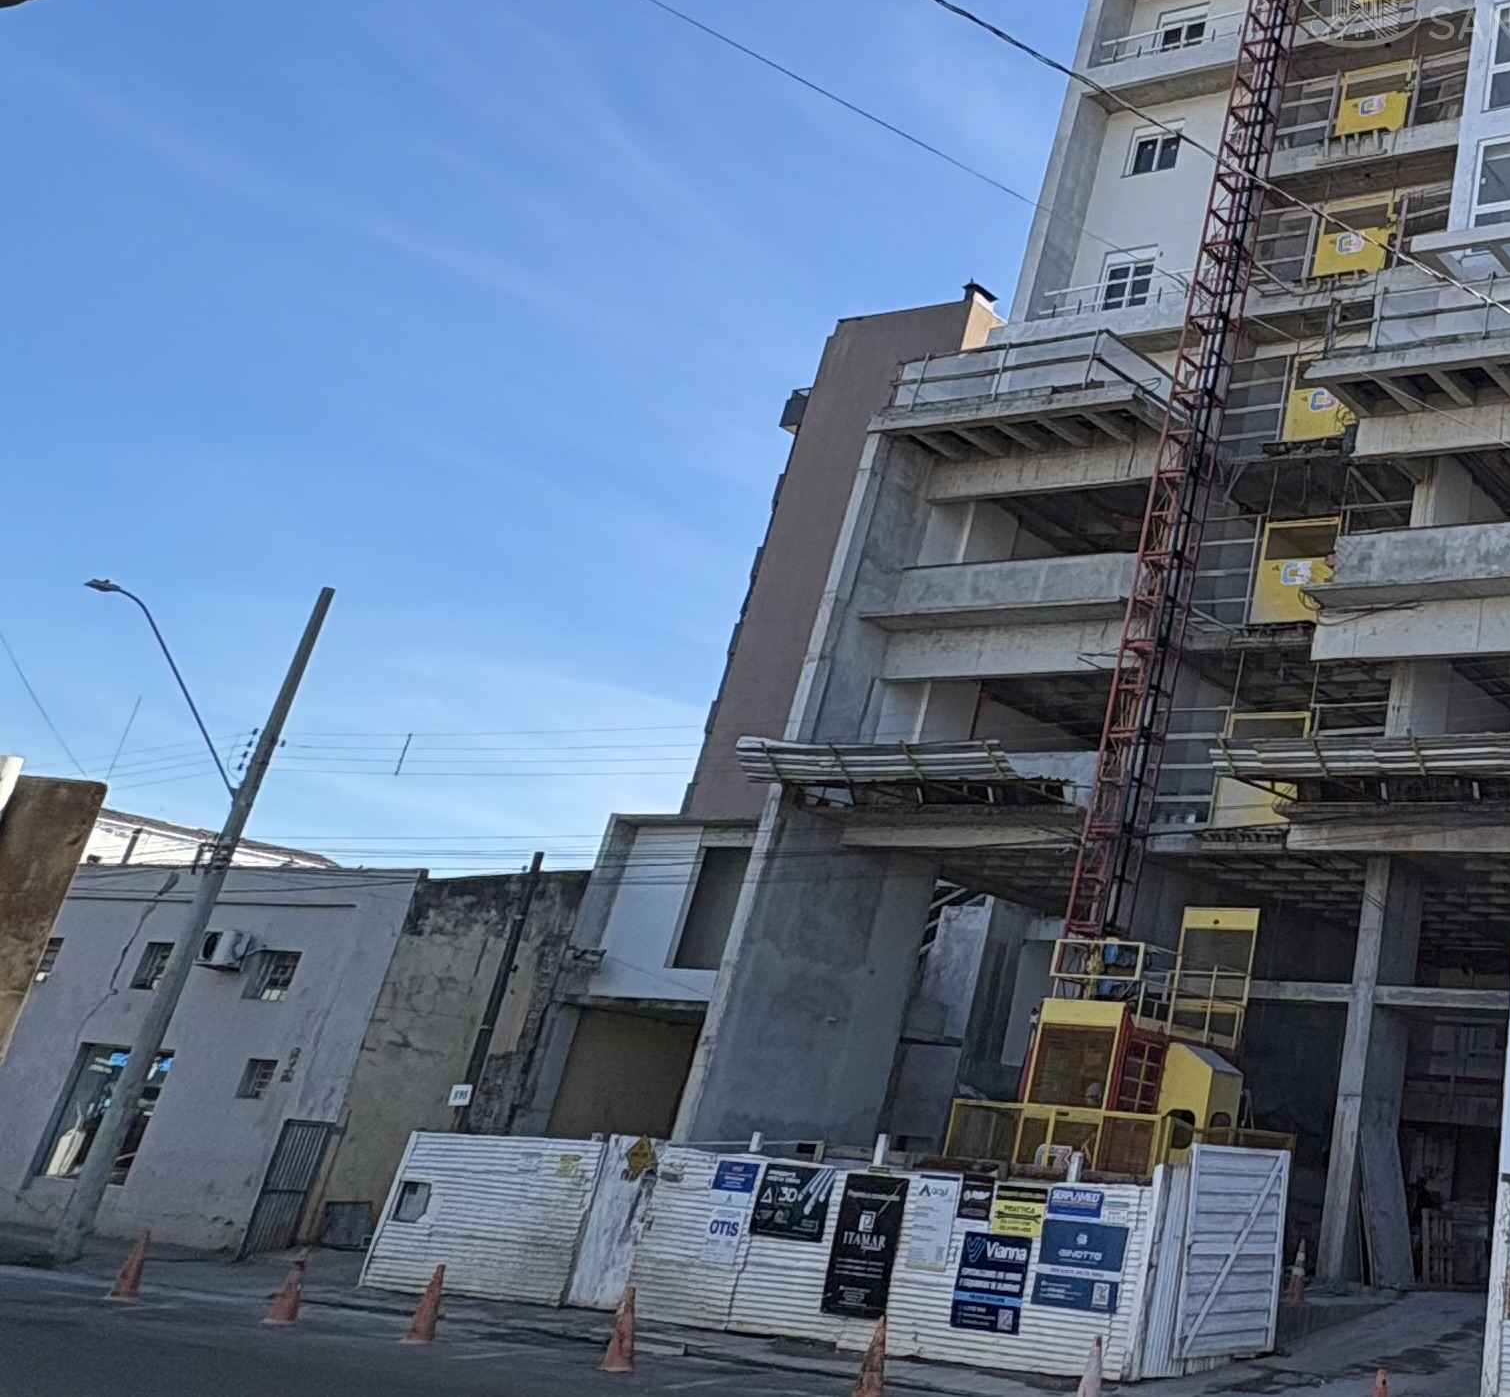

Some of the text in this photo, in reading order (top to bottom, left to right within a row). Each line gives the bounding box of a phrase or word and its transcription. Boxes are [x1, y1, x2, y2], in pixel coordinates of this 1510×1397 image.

[709, 1219, 740, 1237] OTIS
[842, 1231, 887, 1248] ITAMAR
[986, 1240, 1028, 1261] Vianna
